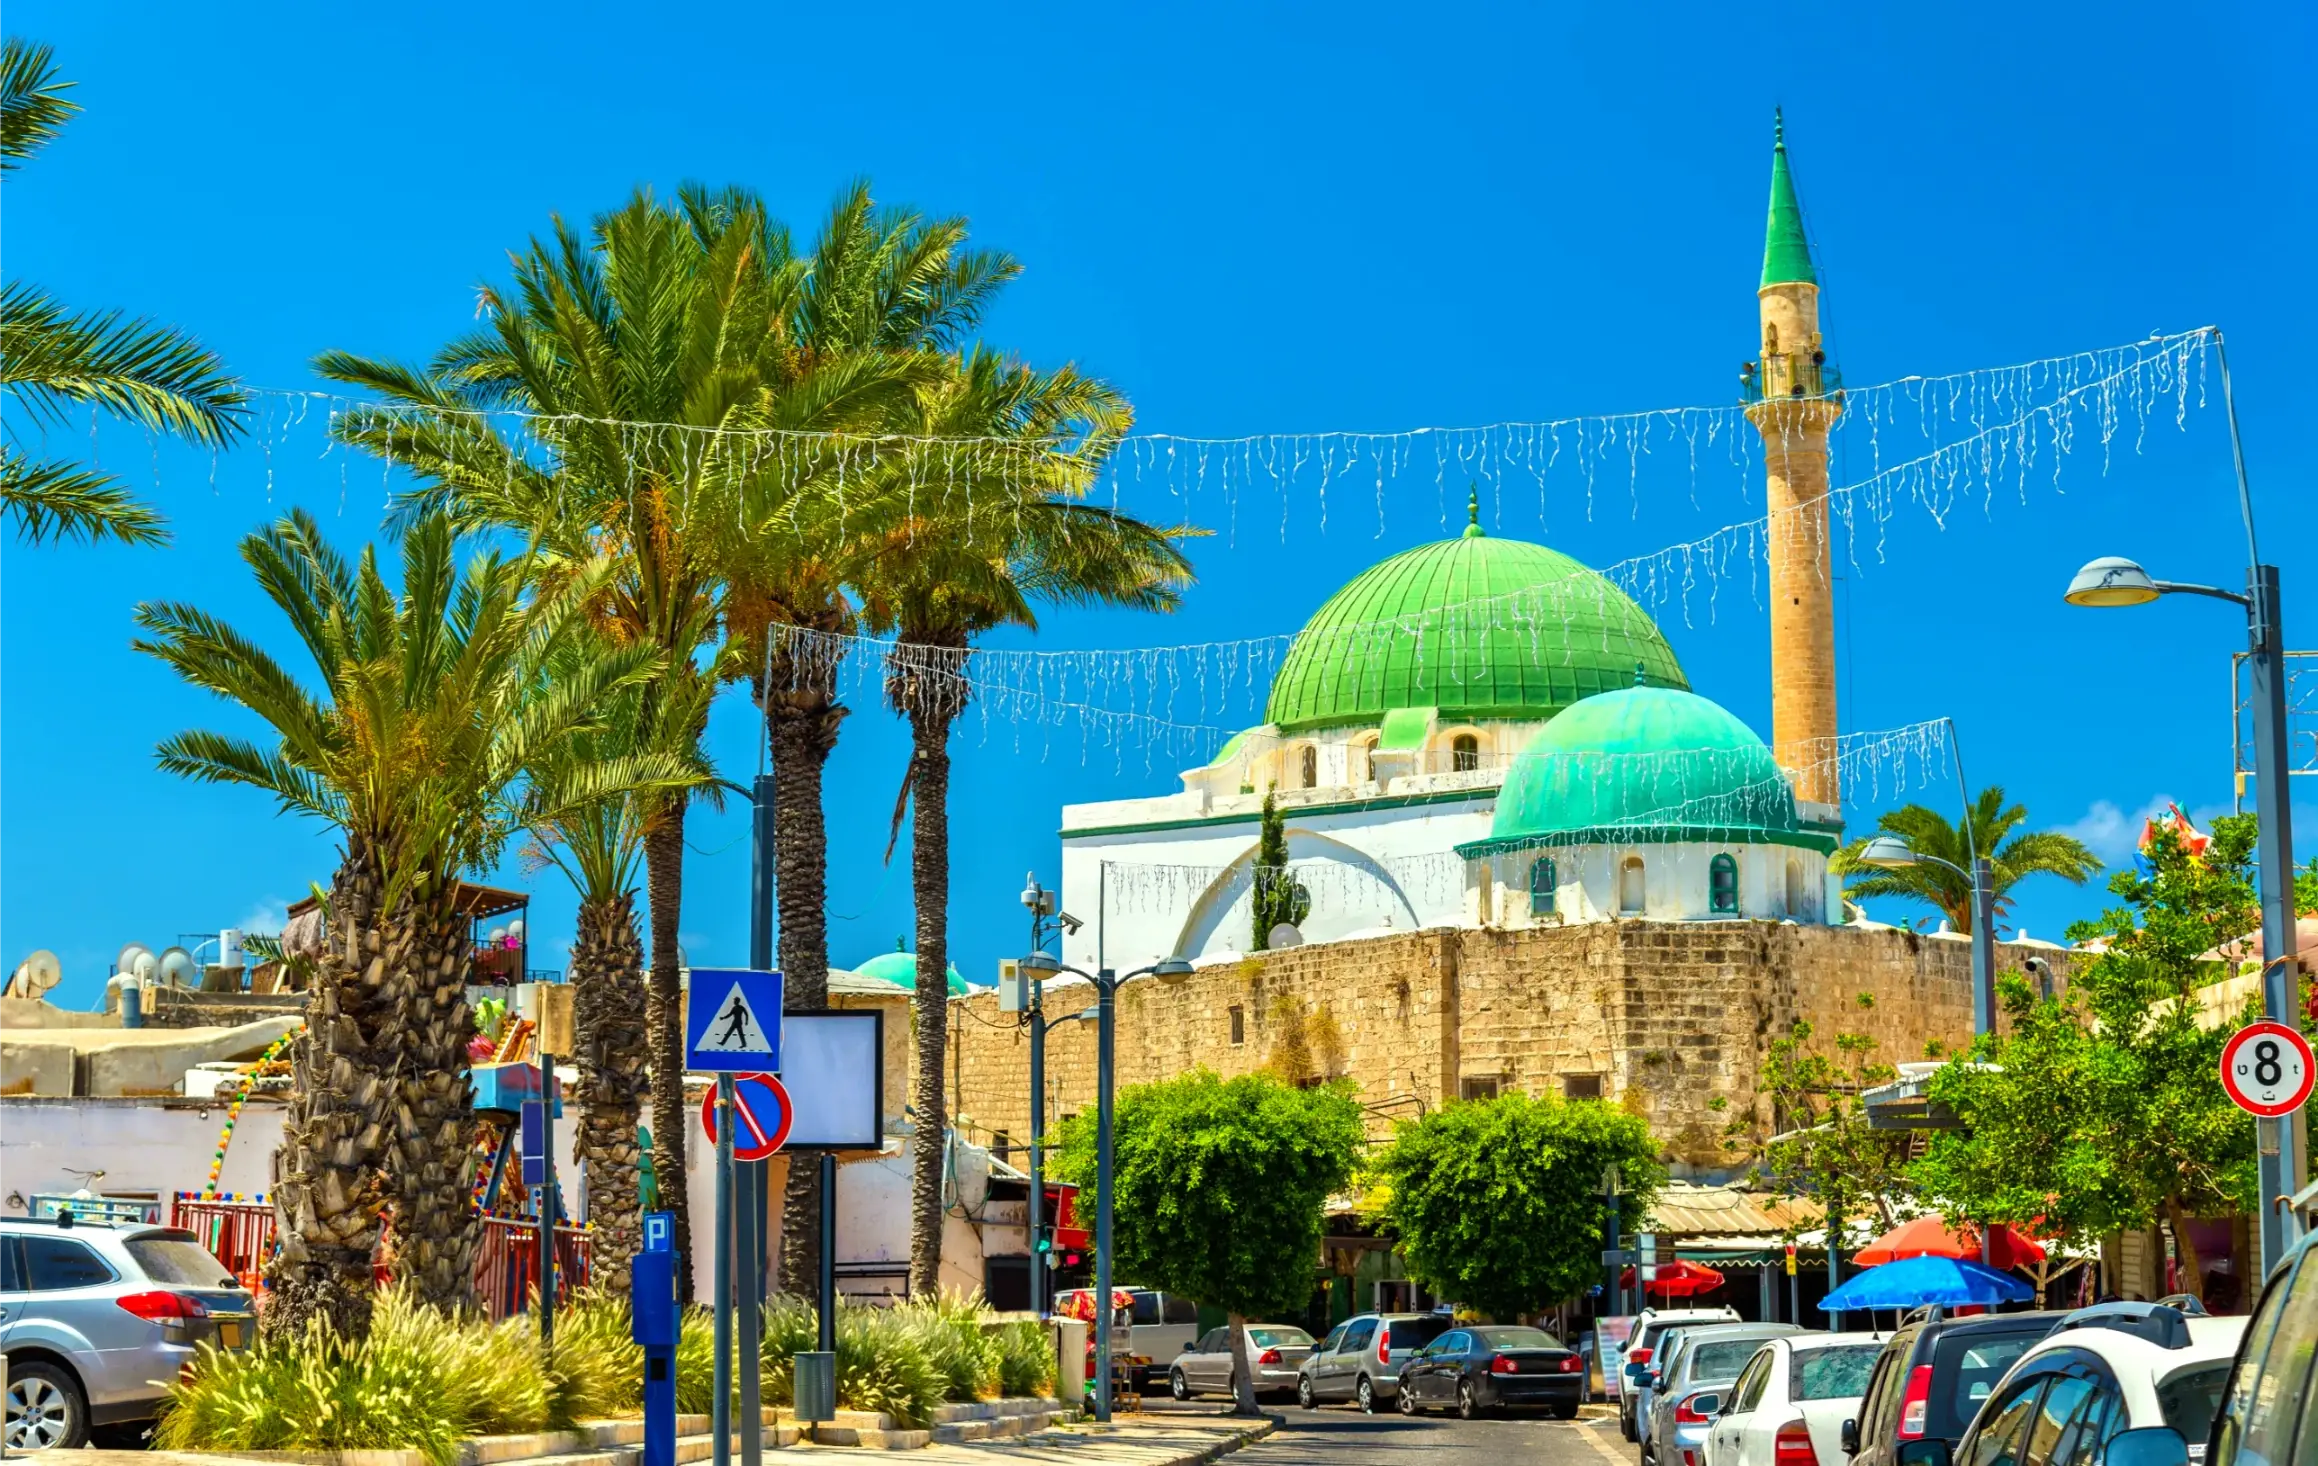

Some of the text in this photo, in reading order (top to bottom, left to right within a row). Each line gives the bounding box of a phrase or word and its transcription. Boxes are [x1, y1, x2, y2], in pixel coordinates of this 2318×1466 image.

[2255, 1040, 2282, 1086] 8
[2293, 1064, 2299, 1075] t
[648, 1219, 665, 1249] P
